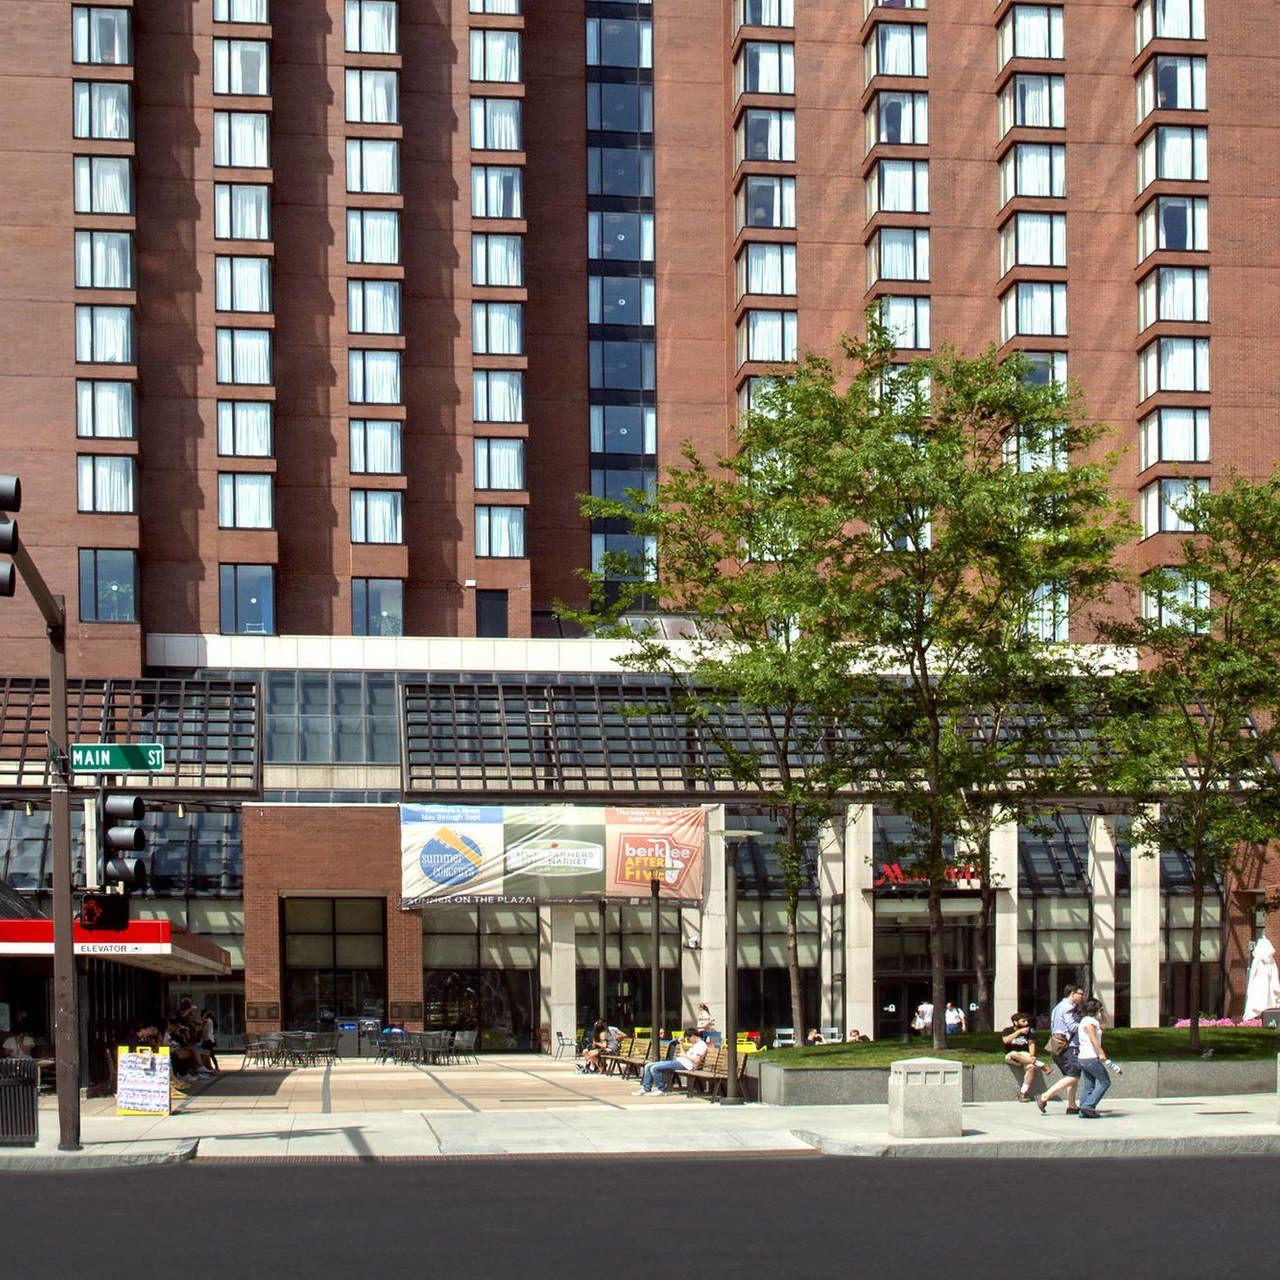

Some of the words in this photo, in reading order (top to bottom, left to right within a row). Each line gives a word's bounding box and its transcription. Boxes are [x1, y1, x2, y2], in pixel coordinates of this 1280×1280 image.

[72, 749, 111, 766] MAIN
[148, 749, 162, 766] ST
[421, 852, 464, 864] summer
[625, 857, 664, 867] AFTER
[455, 896, 471, 904] ON
[473, 896, 495, 904] THE
[497, 896, 536, 904] PLAZA!
[80, 945, 127, 953] ELEVATOR
